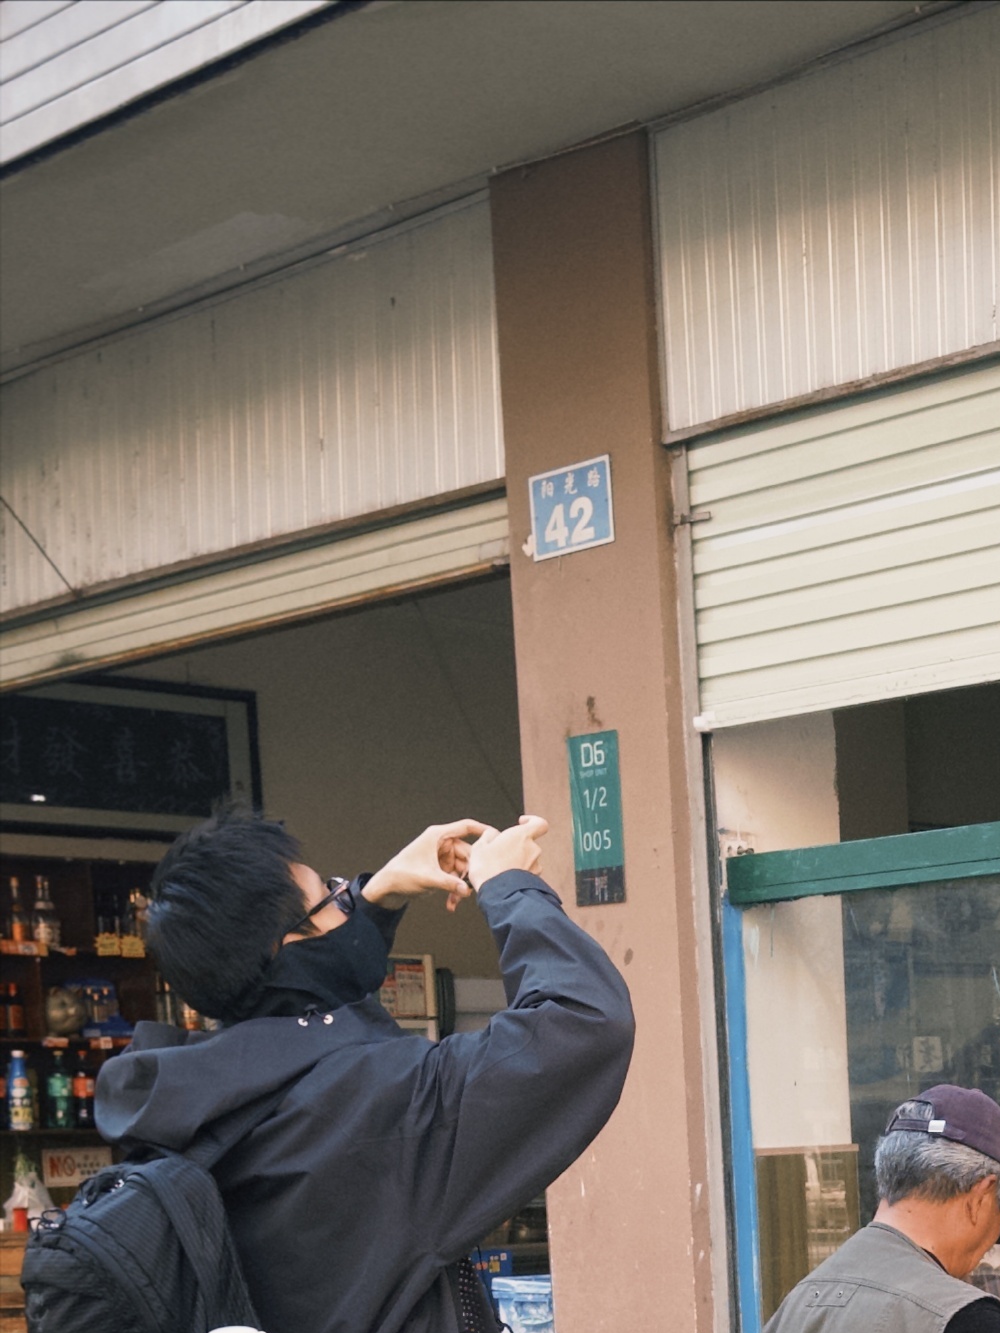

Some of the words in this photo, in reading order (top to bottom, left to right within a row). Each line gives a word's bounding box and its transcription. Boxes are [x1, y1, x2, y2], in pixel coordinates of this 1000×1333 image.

[541, 466, 600, 499] 阳光路
[545, 496, 595, 548] 42
[581, 740, 605, 767] D6
[583, 786, 608, 811] 1/2
[583, 829, 612, 852] 005
[49, 1155, 76, 1178] NO
